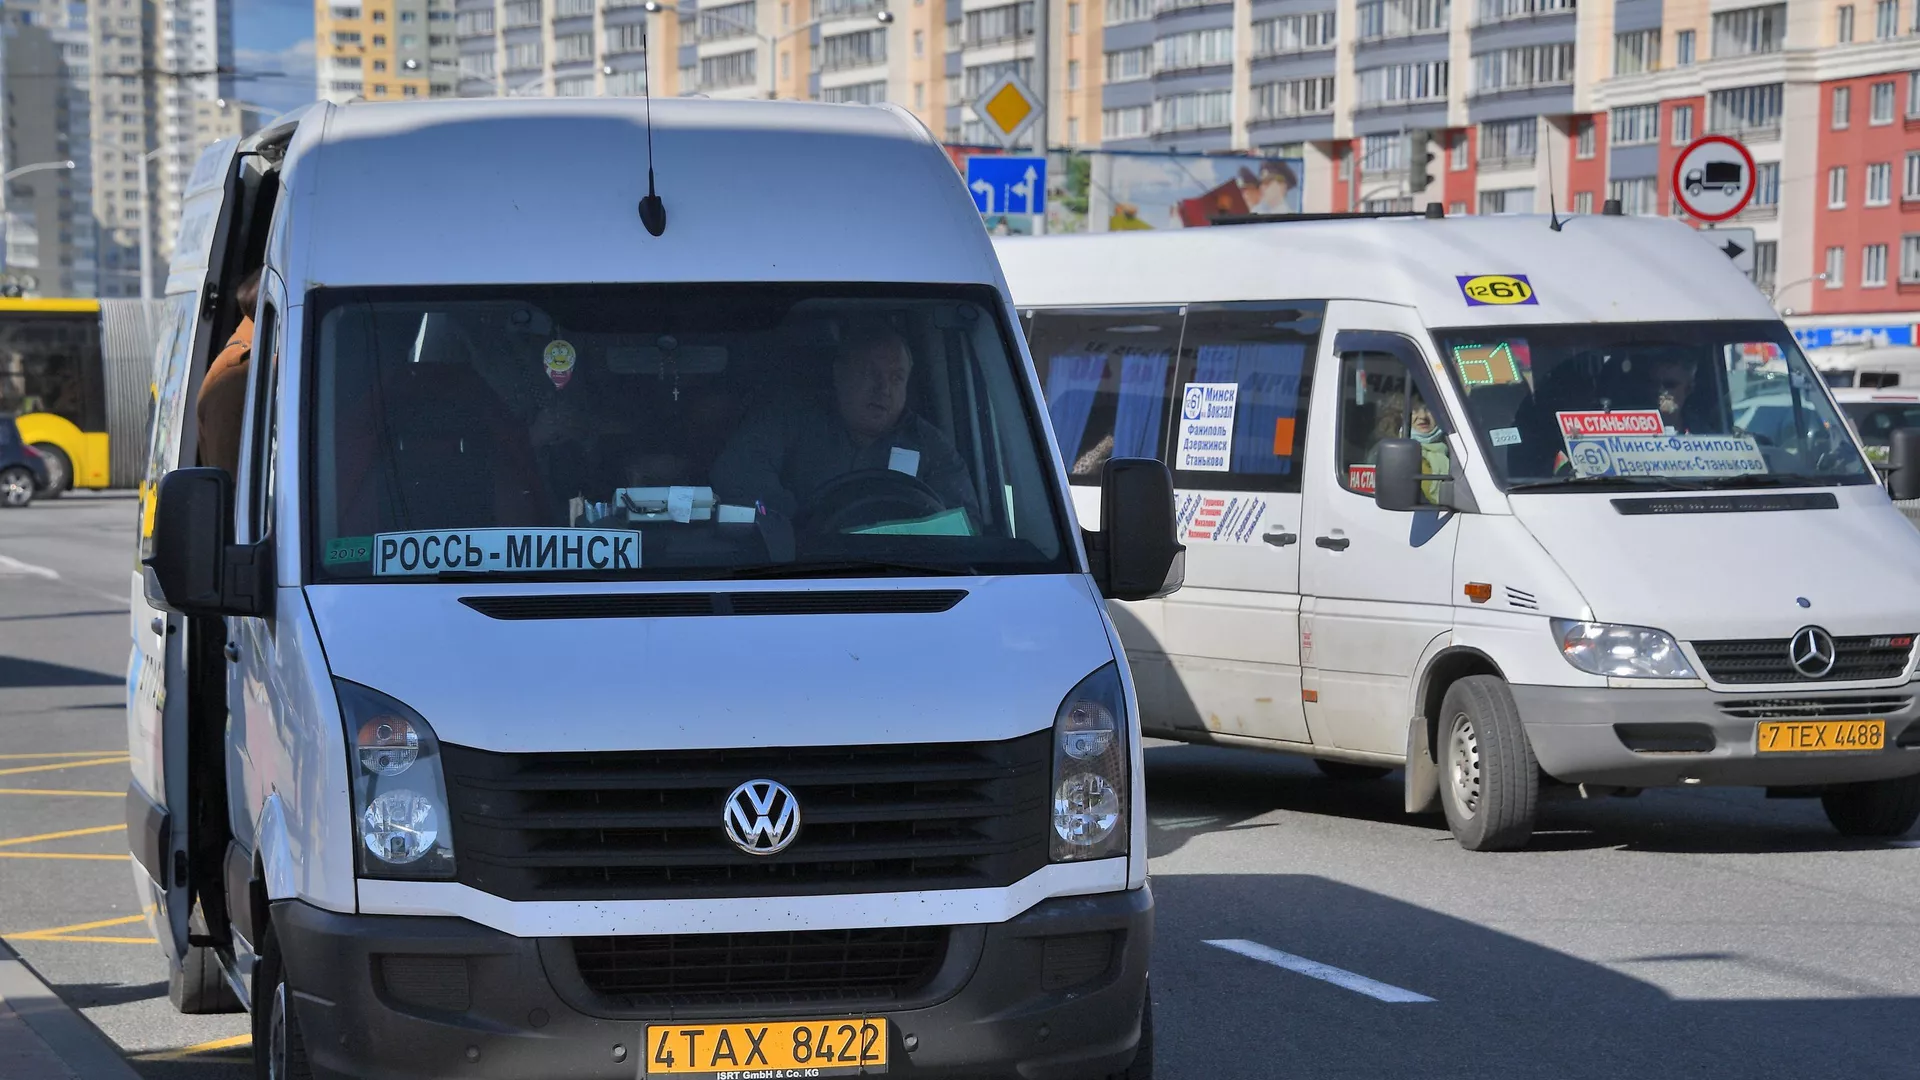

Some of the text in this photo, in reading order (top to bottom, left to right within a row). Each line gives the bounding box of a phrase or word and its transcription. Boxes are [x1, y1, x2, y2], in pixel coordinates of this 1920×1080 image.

[1453, 342, 1519, 385] 61
[1205, 387, 1235, 402] Минск
[1207, 403, 1233, 418] Вокзал
[1188, 424, 1227, 437] Фаниполь
[1564, 416, 1658, 432] НА СТАНЬКОВО
[1183, 438, 1227, 452] Дзержинск
[1608, 437, 1753, 453] Минск-Фаниполь
[1186, 454, 1224, 467] Станьково
[1618, 458, 1763, 476] Дзержинск-Станьково
[1350, 471, 1376, 488] НА СТА
[330, 548, 366, 560] 2019
[381, 534, 633, 572] РОССЬ-МИНСК
[1835, 724, 1880, 746] 4488
[792, 1023, 879, 1064] 8422
[717, 1069, 819, 1080] ISRT GmbH & Co. KG
